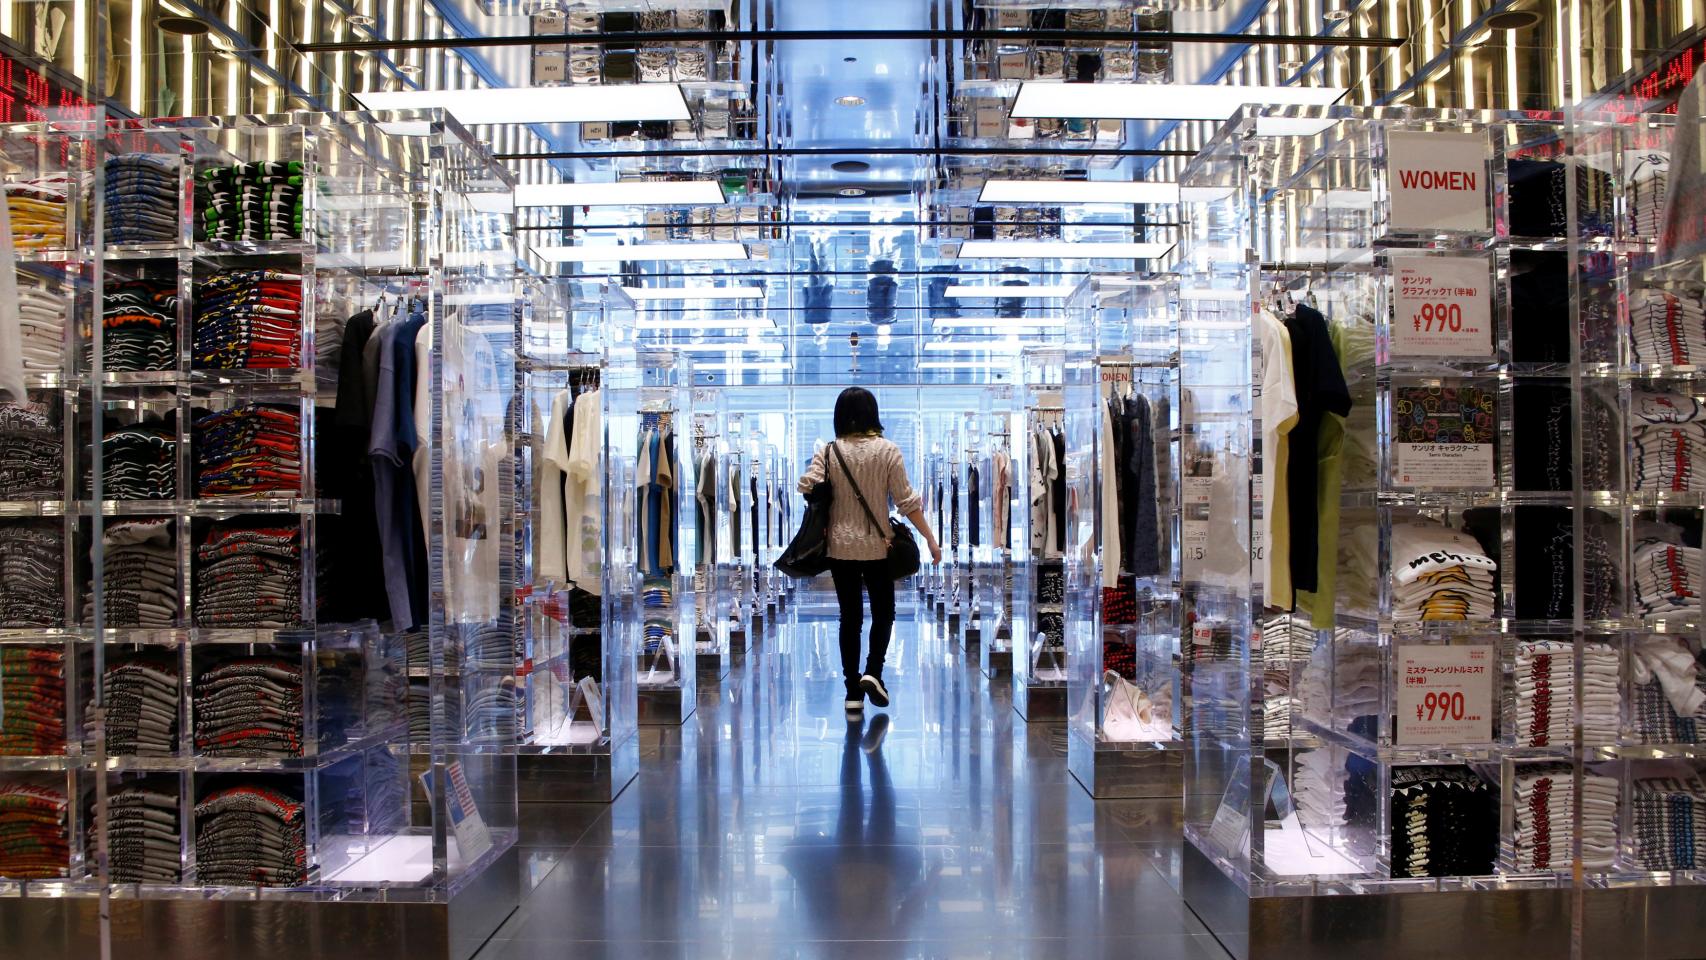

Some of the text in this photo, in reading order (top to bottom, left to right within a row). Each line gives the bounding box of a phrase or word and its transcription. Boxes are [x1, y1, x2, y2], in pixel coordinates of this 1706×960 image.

[1399, 169, 1476, 191] WOMEN
[1401, 277, 1432, 285] サンリオ
[1413, 303, 1462, 333] ¥990
[1101, 373, 1128, 382] OMEN
[1406, 666, 1485, 674] ミスターメンリトルミスT
[1416, 691, 1464, 721] ¥990
